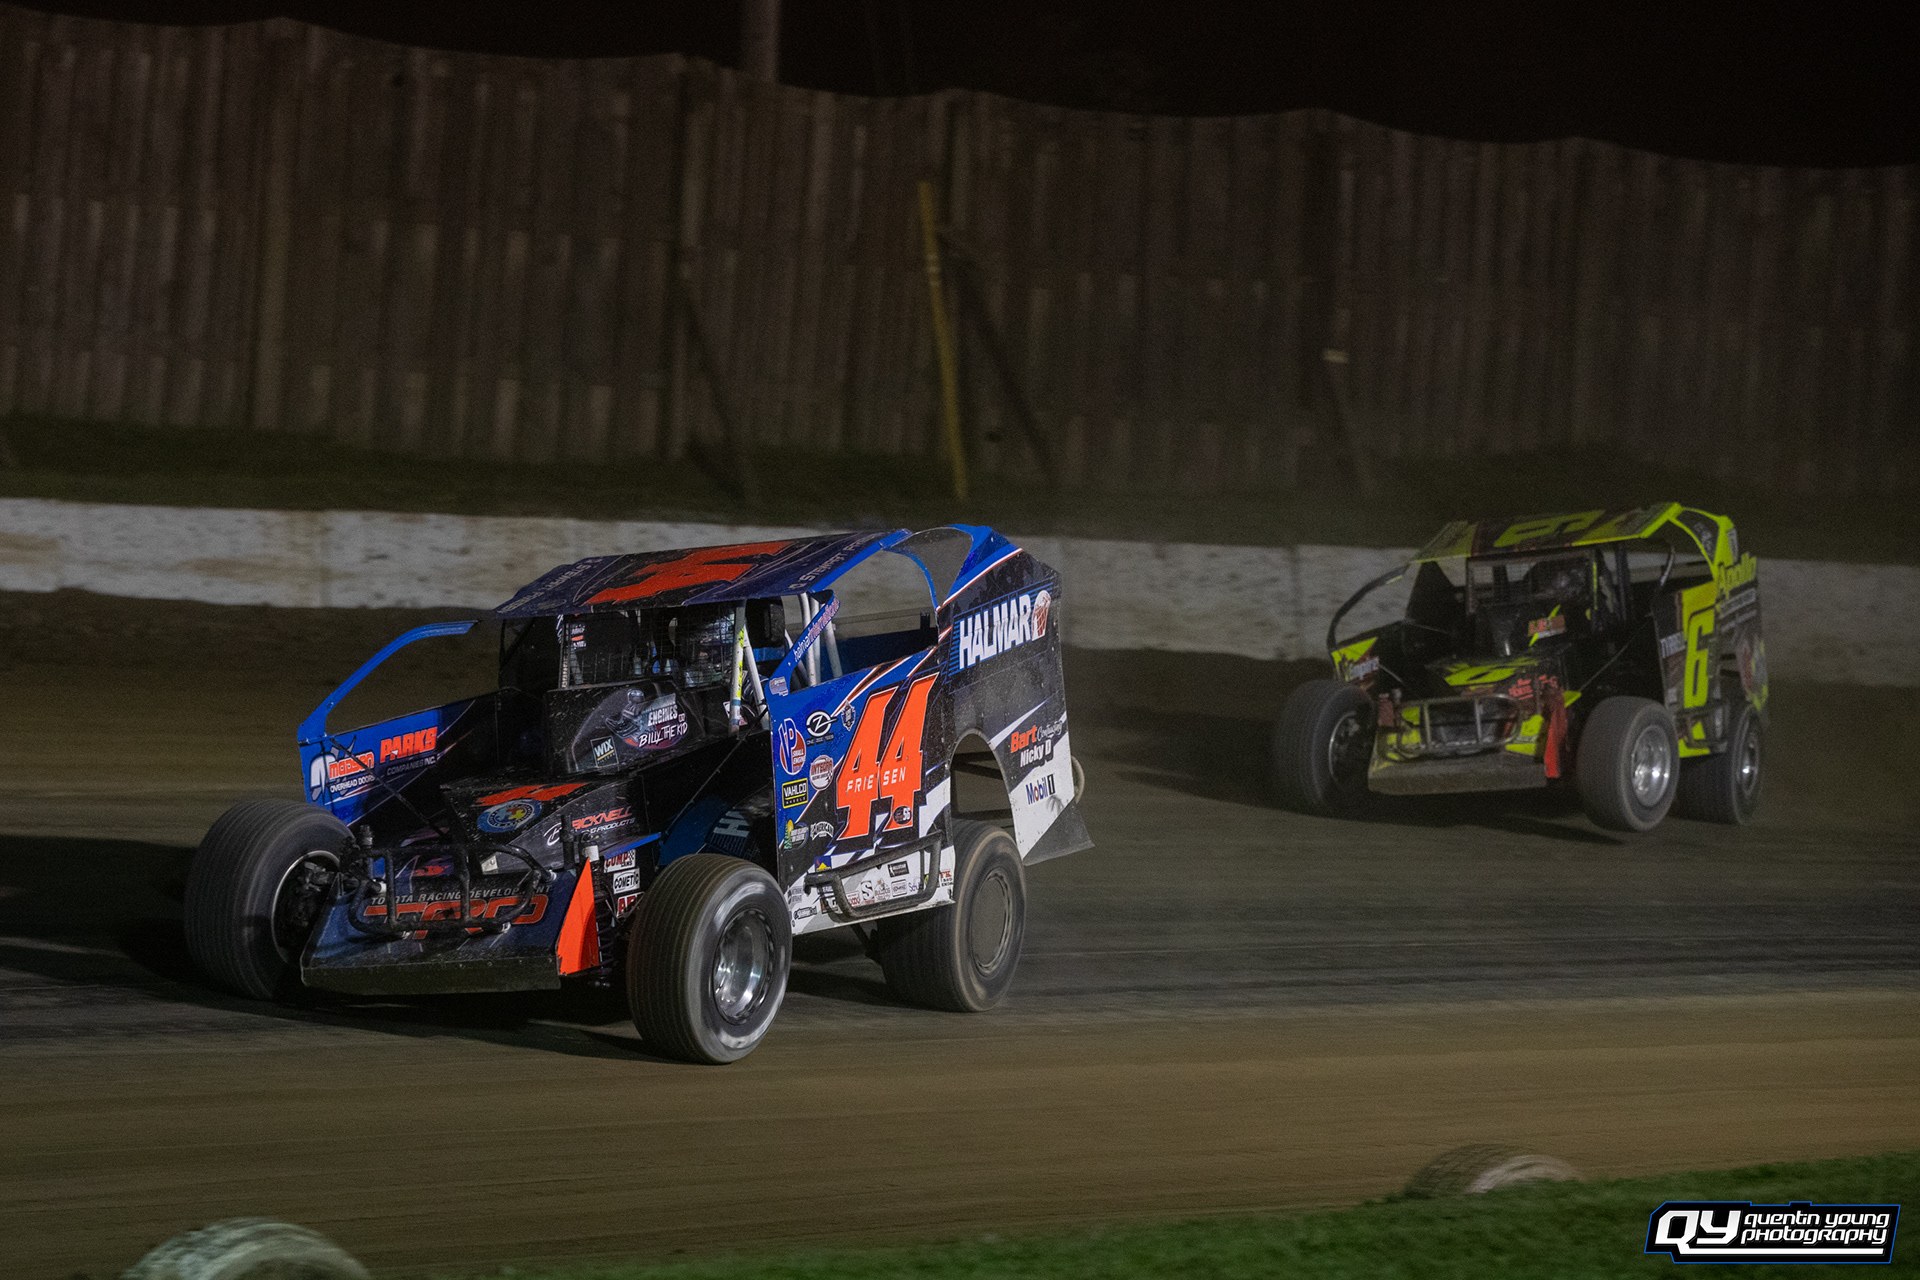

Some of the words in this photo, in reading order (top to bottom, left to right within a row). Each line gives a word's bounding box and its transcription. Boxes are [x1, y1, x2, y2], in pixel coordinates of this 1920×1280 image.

[958, 593, 1032, 671] HALMAR
[1684, 606, 1715, 709] 6
[647, 704, 678, 727] ENGINES
[380, 726, 438, 763] PARKS
[593, 738, 614, 757] WIX
[639, 729, 664, 748] BILLY
[661, 725, 676, 740] THE
[676, 722, 688, 736] KID
[1010, 724, 1038, 753] Bart
[386, 759, 424, 776] COMPANIES
[424, 755, 437, 768] INC.
[836, 672, 940, 841] 44
[1020, 743, 1044, 768] Nicky
[1045, 739, 1052, 755] D
[330, 778, 358, 793] OVERHEAD
[783, 782, 807, 797] VAHLCO
[846, 766, 907, 793] FRIESEN
[1026, 776, 1048, 805] Mobil
[1047, 774, 1056, 796] 1
[371, 895, 413, 905] TOOTA
[418, 891, 462, 902] RACING
[468, 884, 552, 899] DEVELOPNT
